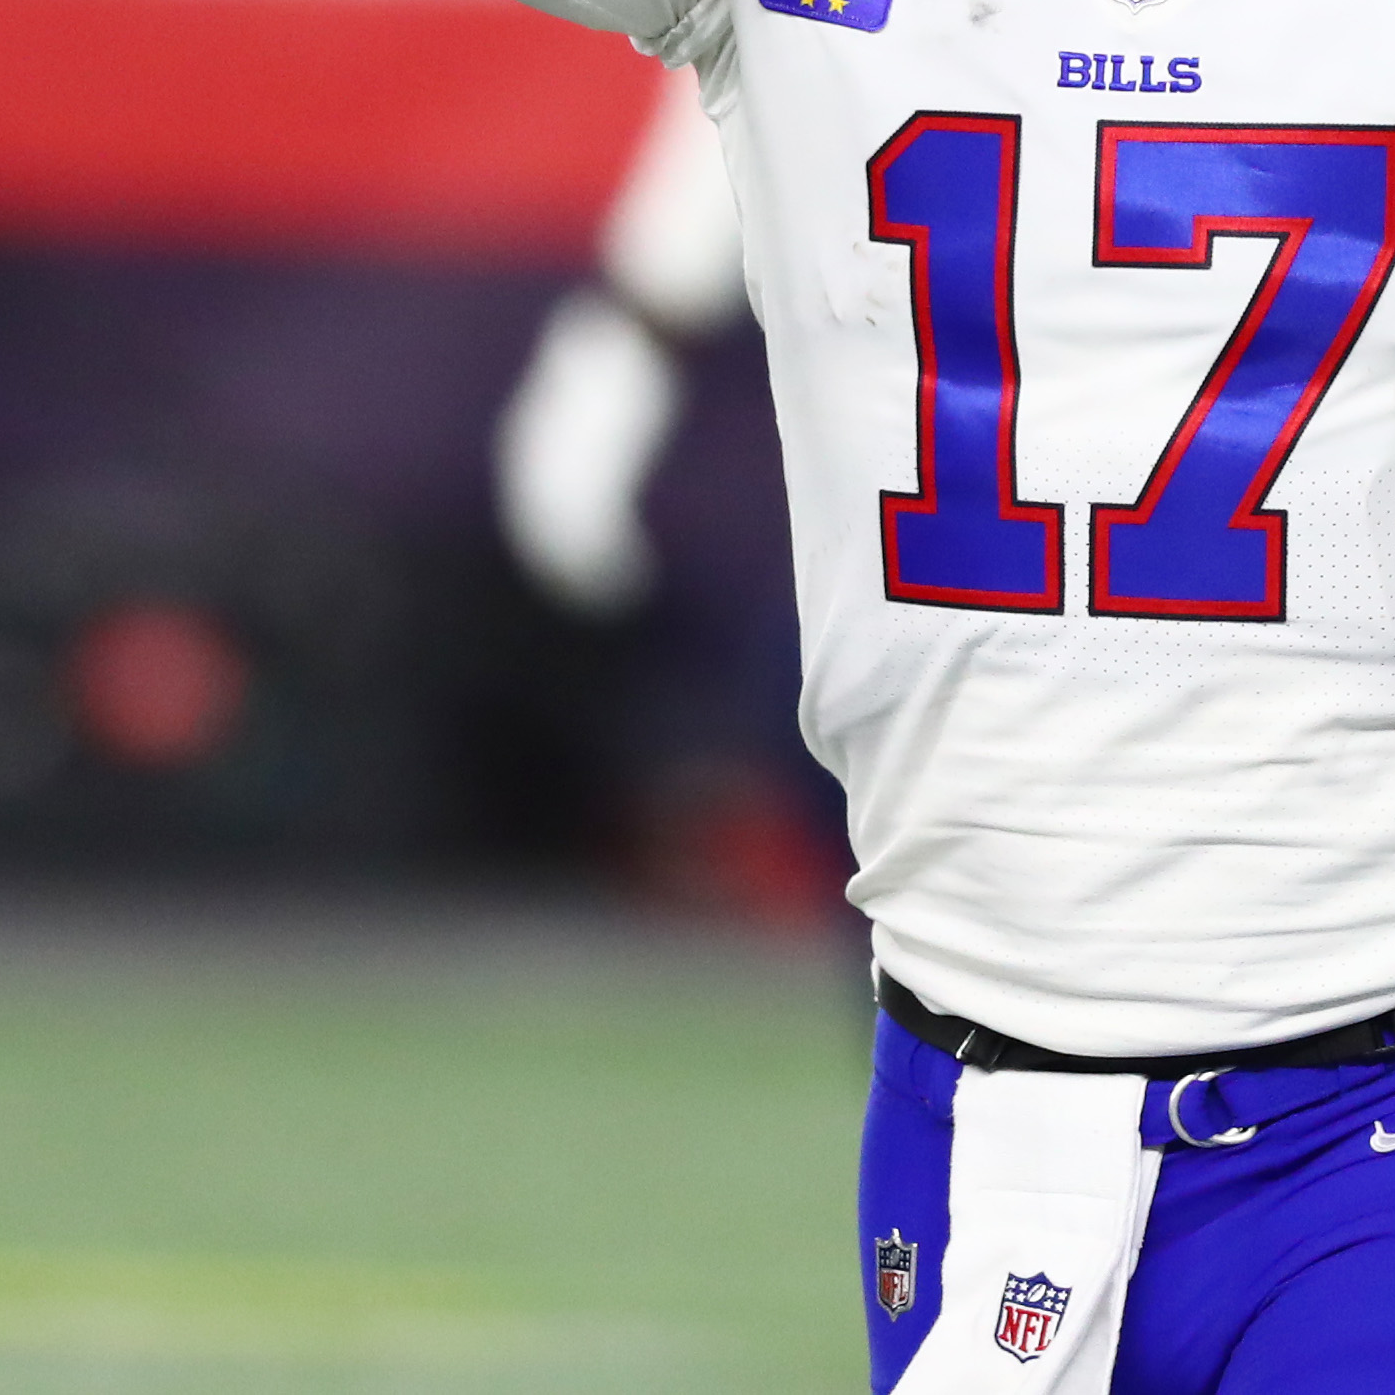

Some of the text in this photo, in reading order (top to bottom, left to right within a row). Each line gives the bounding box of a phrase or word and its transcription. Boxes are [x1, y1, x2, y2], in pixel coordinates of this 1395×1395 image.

[1057, 51, 1202, 93] BILLS
[880, 1272, 907, 1303] NFL
[998, 1305, 1053, 1353] NFL
